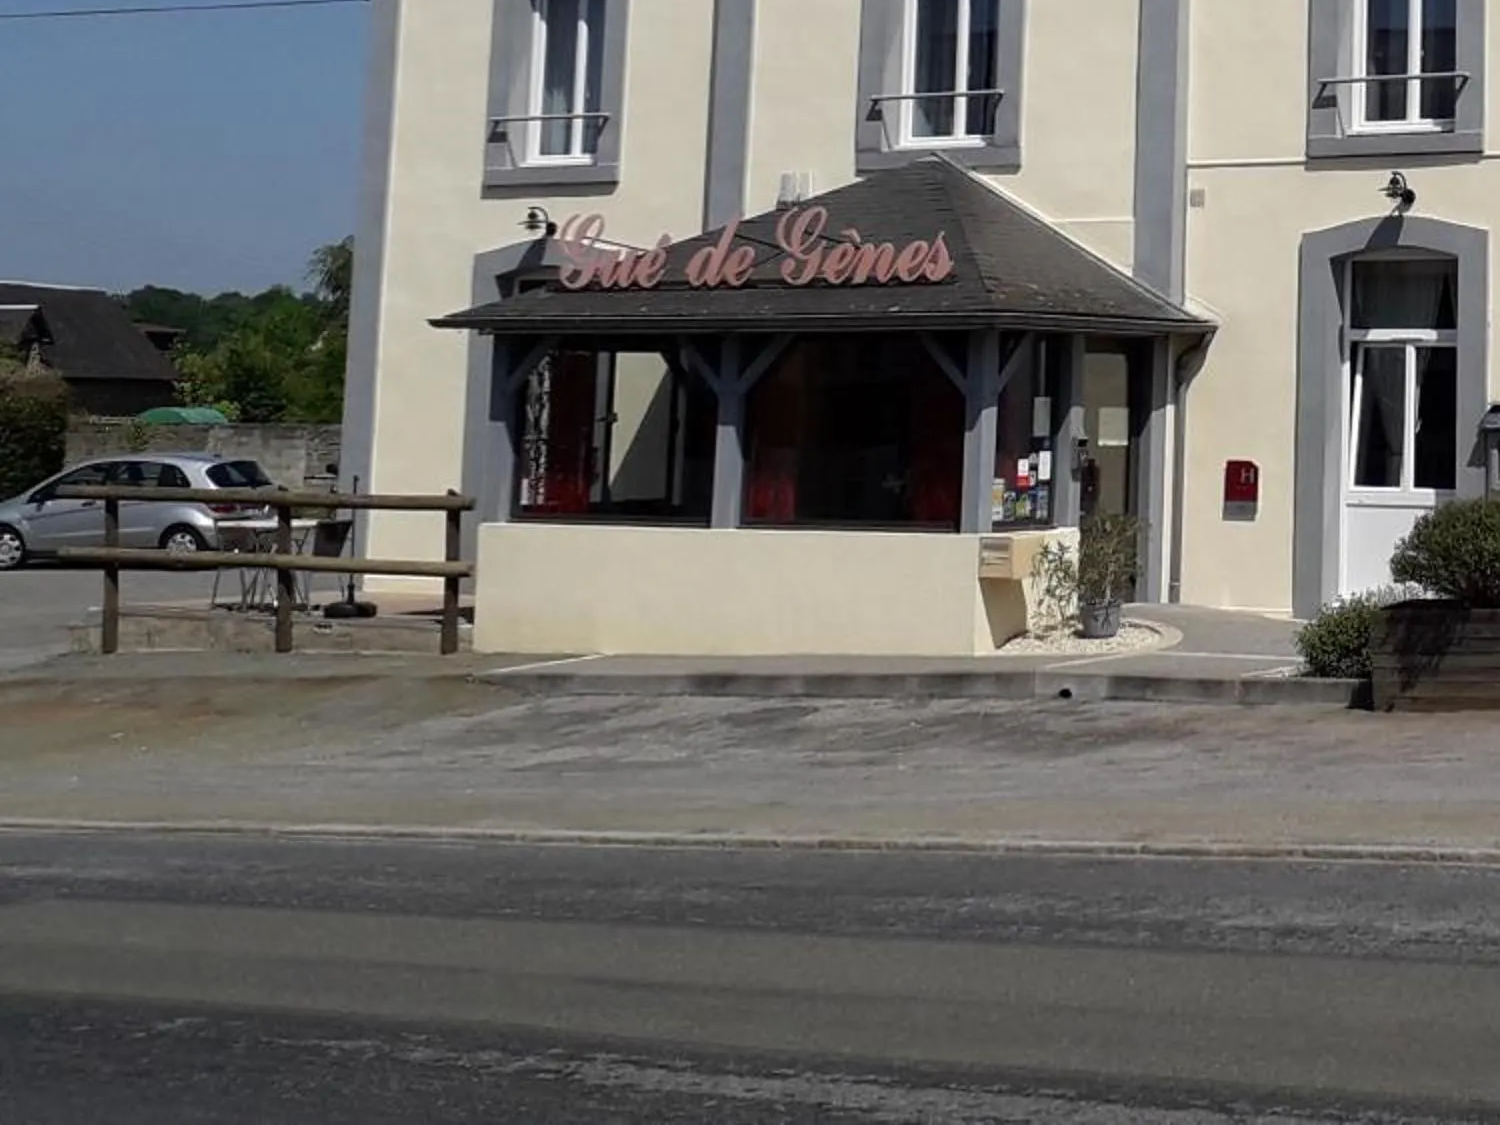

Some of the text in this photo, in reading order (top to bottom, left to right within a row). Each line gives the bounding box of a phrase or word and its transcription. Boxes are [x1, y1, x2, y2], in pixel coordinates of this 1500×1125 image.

[559, 207, 954, 289] Gué de Gênes
